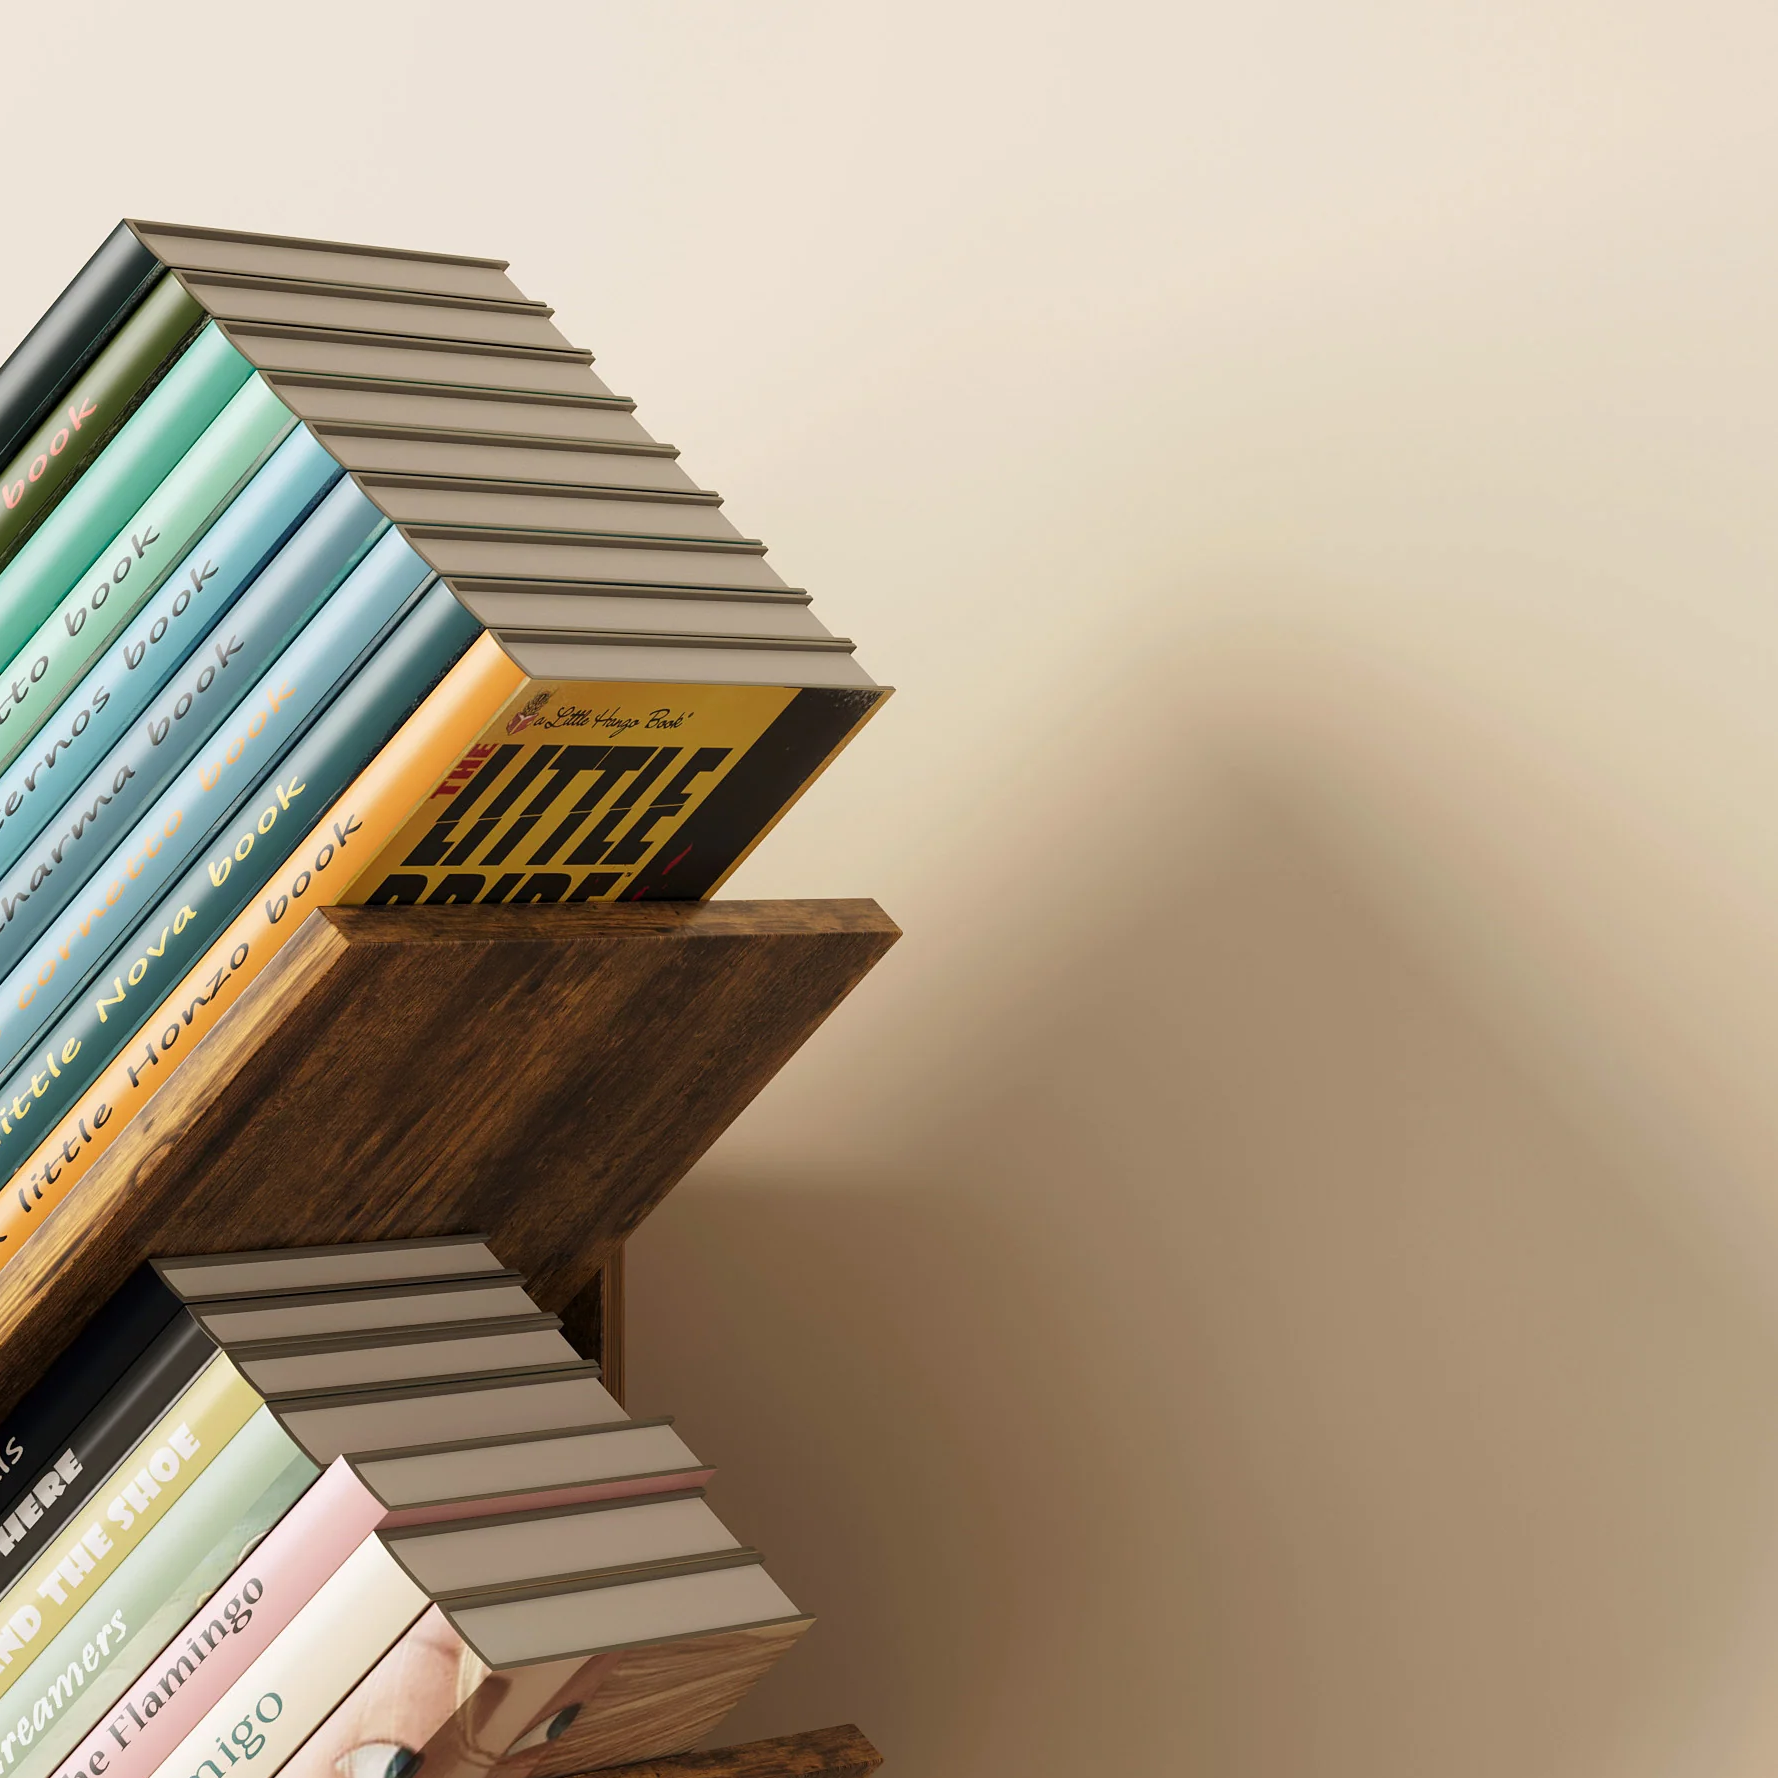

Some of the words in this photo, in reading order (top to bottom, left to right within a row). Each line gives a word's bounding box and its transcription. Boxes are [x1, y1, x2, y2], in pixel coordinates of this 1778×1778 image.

[4, 404, 96, 508] book
[65, 526, 160, 636] book
[127, 566, 219, 669] book
[152, 641, 244, 745] book
[399, 743, 734, 867] LITTLE
[428, 743, 499, 799] THE
[17, 809, 182, 1010] cornetto
[199, 680, 296, 791] book
[95, 904, 197, 1023] Nova
[208, 775, 306, 886] book
[19, 1103, 112, 1212] little
[128, 943, 249, 1087] Honzo
[267, 814, 362, 924] book
[36, 1521, 113, 1605] THE
[106, 1421, 201, 1530] SHOE
[108, 1578, 263, 1751] Flamingo
